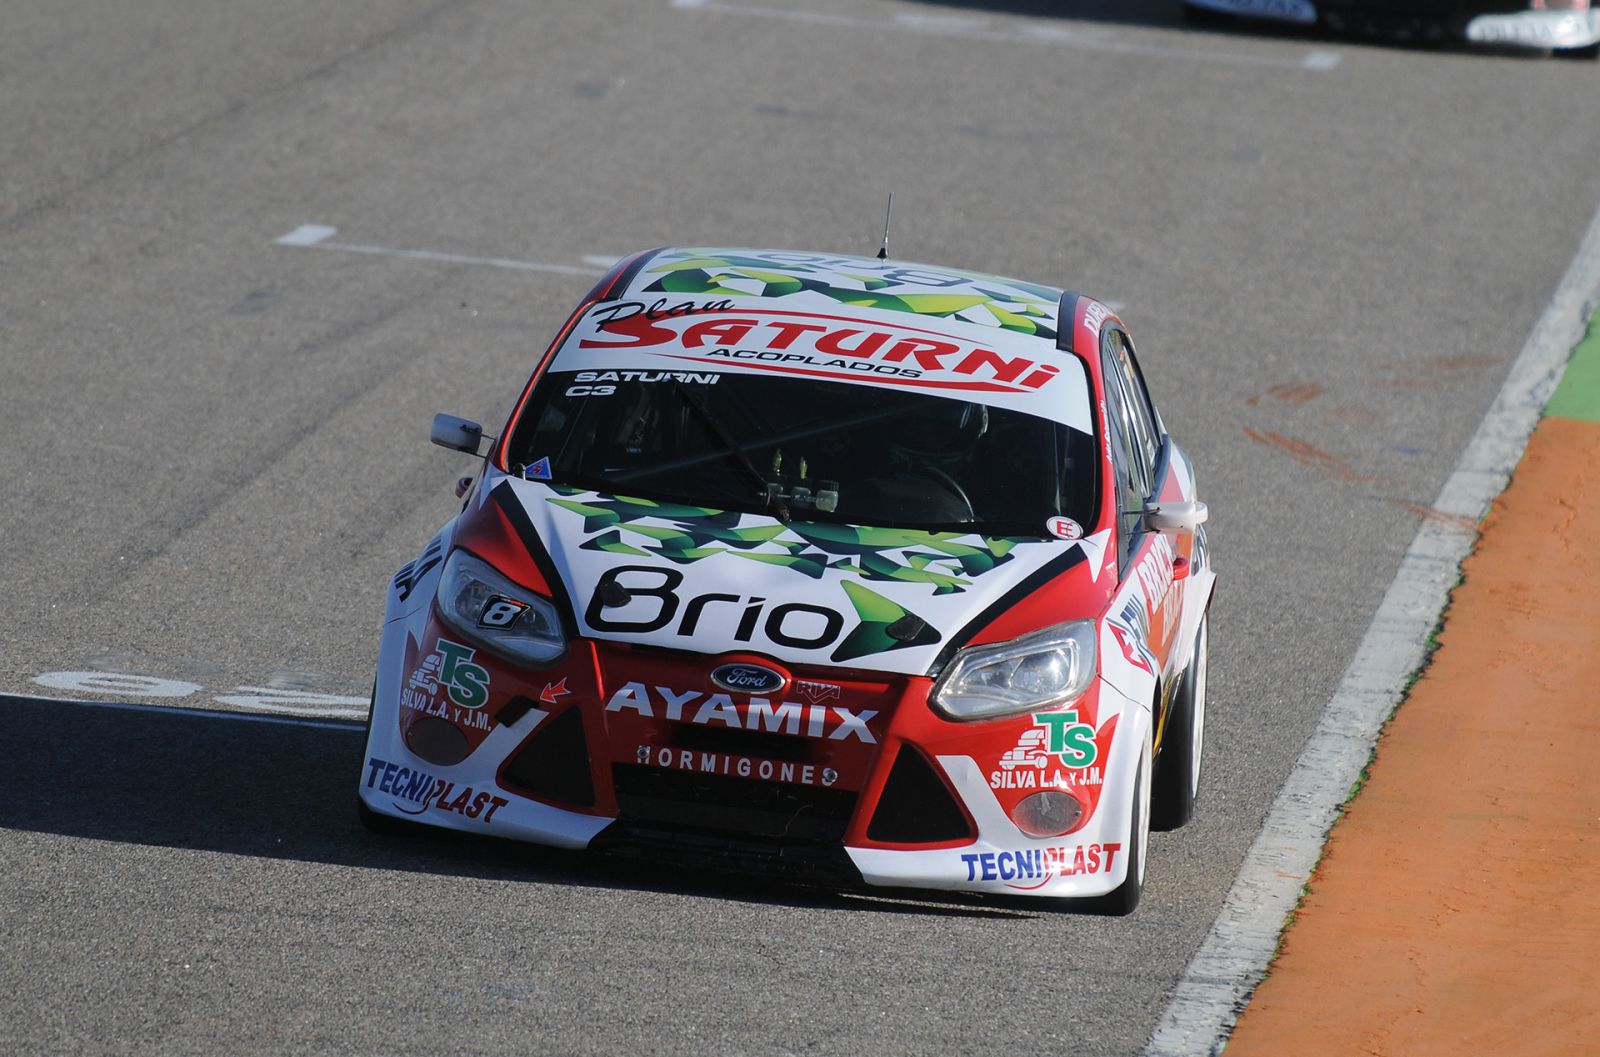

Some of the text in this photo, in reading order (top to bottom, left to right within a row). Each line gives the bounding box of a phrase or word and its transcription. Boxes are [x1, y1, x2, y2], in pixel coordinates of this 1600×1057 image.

[591, 297, 735, 333] Plan
[574, 371, 720, 385] SATURNI
[706, 347, 923, 378] ACOPLADOS
[565, 385, 616, 397] C3
[1056, 521, 1073, 538] E
[483, 601, 522, 626] 8
[584, 565, 844, 650] Brio
[436, 638, 490, 709] TS
[726, 667, 767, 687] Ford
[401, 688, 492, 732] SILVA L.A. Y J.M.
[605, 681, 879, 744] AYAMIX
[1033, 711, 1098, 768] TS
[367, 757, 509, 823] TECNIPLAST
[990, 771, 1036, 790] SILVA
[1069, 772, 1077, 786] Y
[1078, 766, 1103, 785] J.M.
[961, 842, 1122, 882] TECNIPLAST
